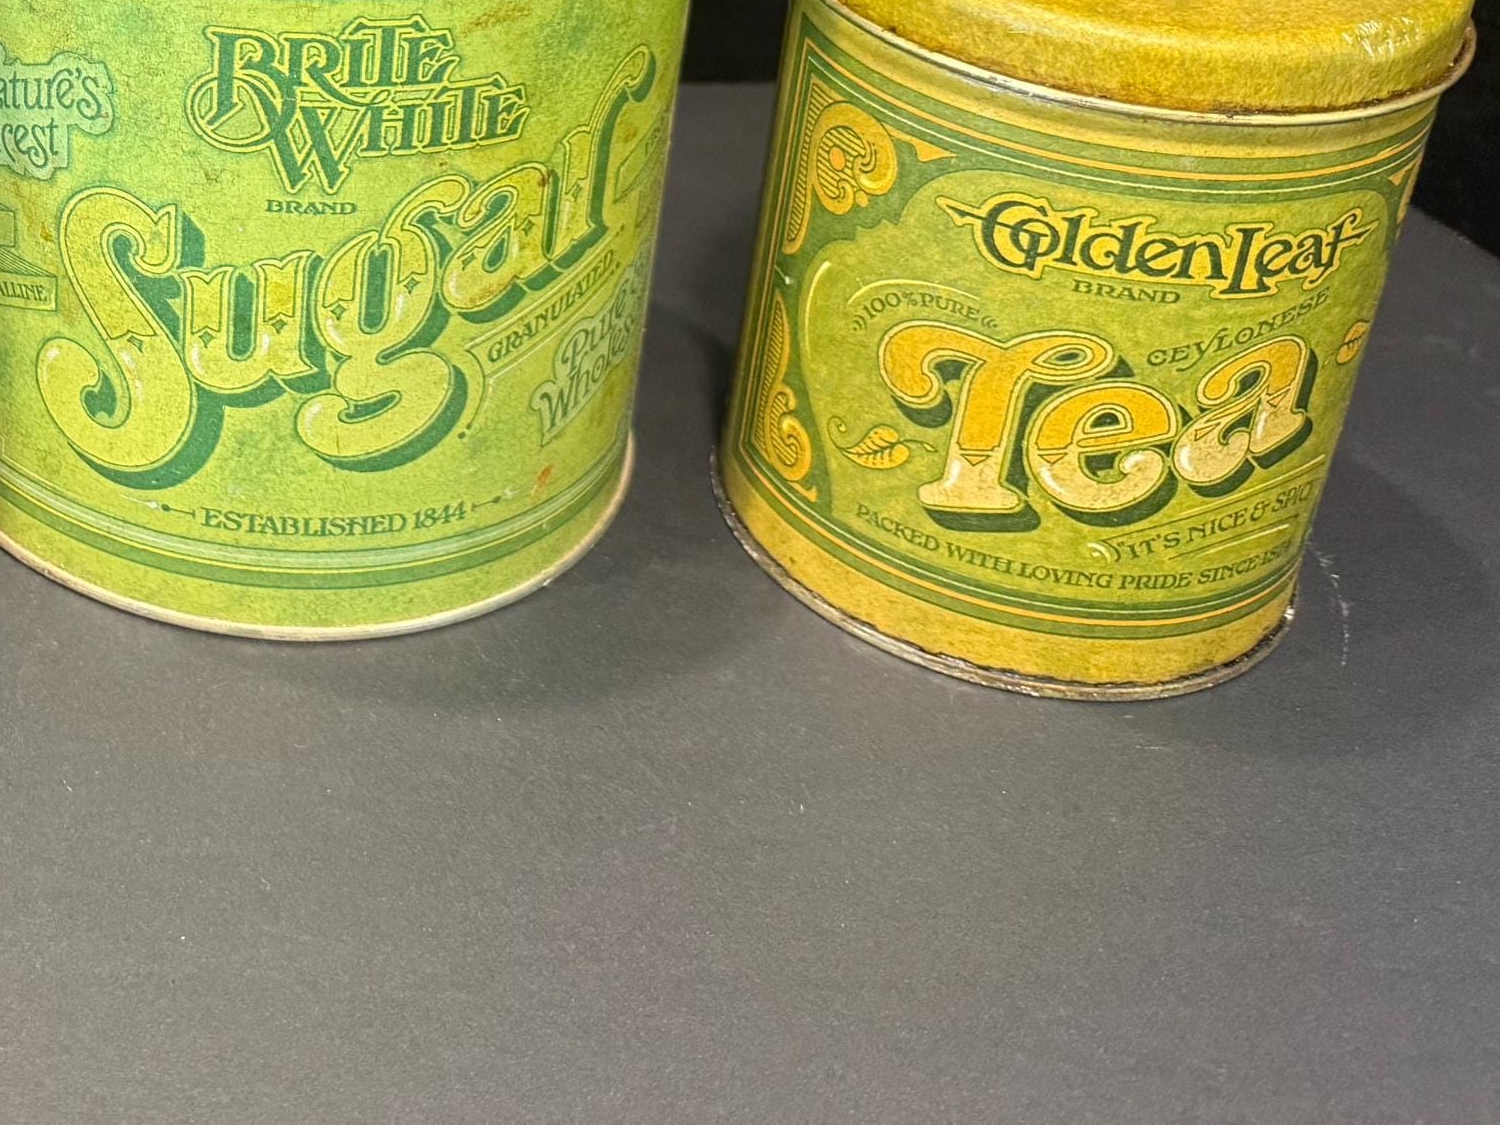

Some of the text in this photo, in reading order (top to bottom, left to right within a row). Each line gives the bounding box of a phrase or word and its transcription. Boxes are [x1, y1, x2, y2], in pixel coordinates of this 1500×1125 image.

[186, 14, 458, 151] BRITE
[270, 73, 530, 193] WHITE
[266, 199, 358, 215] BRAND
[36, 45, 655, 489] Sugar
[487, 249, 615, 363] GRANULATED
[862, 291, 981, 321] 100% PURE
[1071, 279, 1181, 304] BRAND
[1146, 287, 1330, 372] CEYLONESE
[878, 320, 1316, 531] Tea
[200, 500, 467, 536] ESTABLISHED 1844
[855, 503, 941, 552] PACKED
[946, 542, 1013, 573] WITH
[1018, 562, 1113, 590] LOVING
[1118, 572, 1193, 590] PRIDE
[1197, 554, 1260, 584] SINCE
[1186, 507, 1247, 542] NICE
[1250, 500, 1270, 522] &
